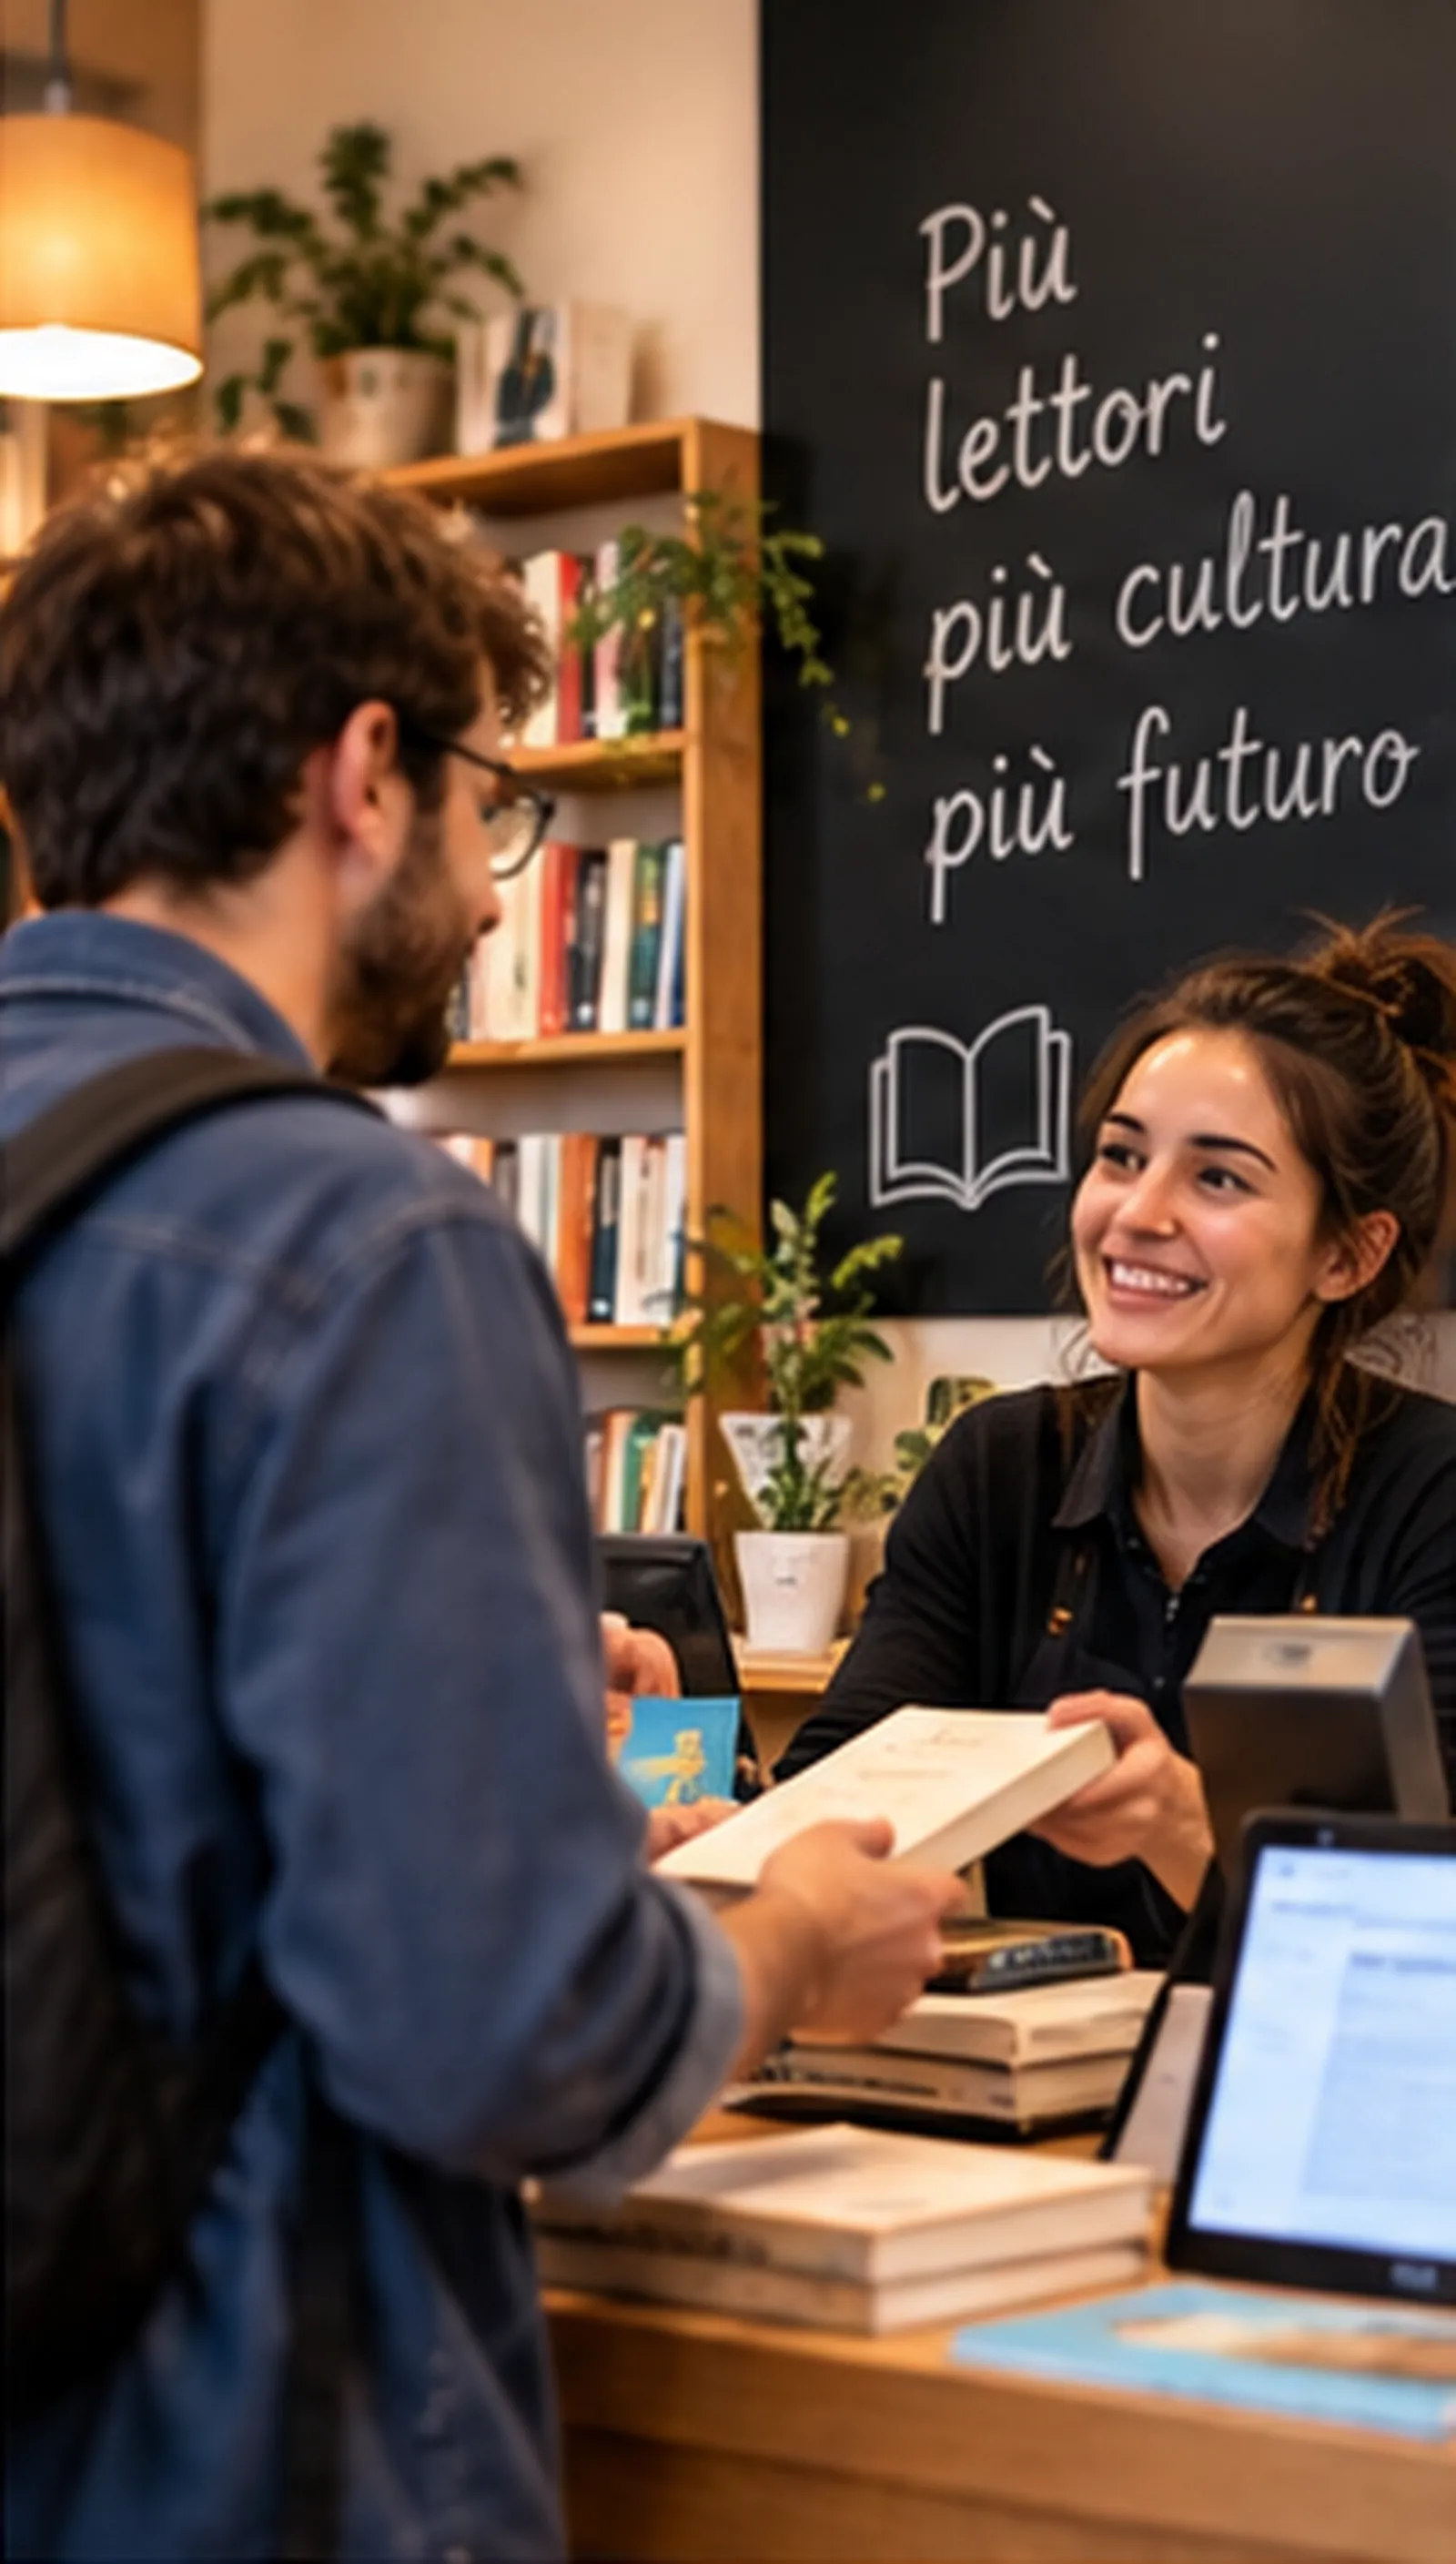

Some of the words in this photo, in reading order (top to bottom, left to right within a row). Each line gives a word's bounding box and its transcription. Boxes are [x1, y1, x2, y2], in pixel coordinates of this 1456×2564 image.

[920, 197, 1077, 342] Più
[925, 332, 1227, 513] lettori
[924, 552, 1072, 735] più
[1116, 490, 1456, 648] cultura
[925, 745, 1074, 924] più
[1117, 705, 1420, 881] futuro
